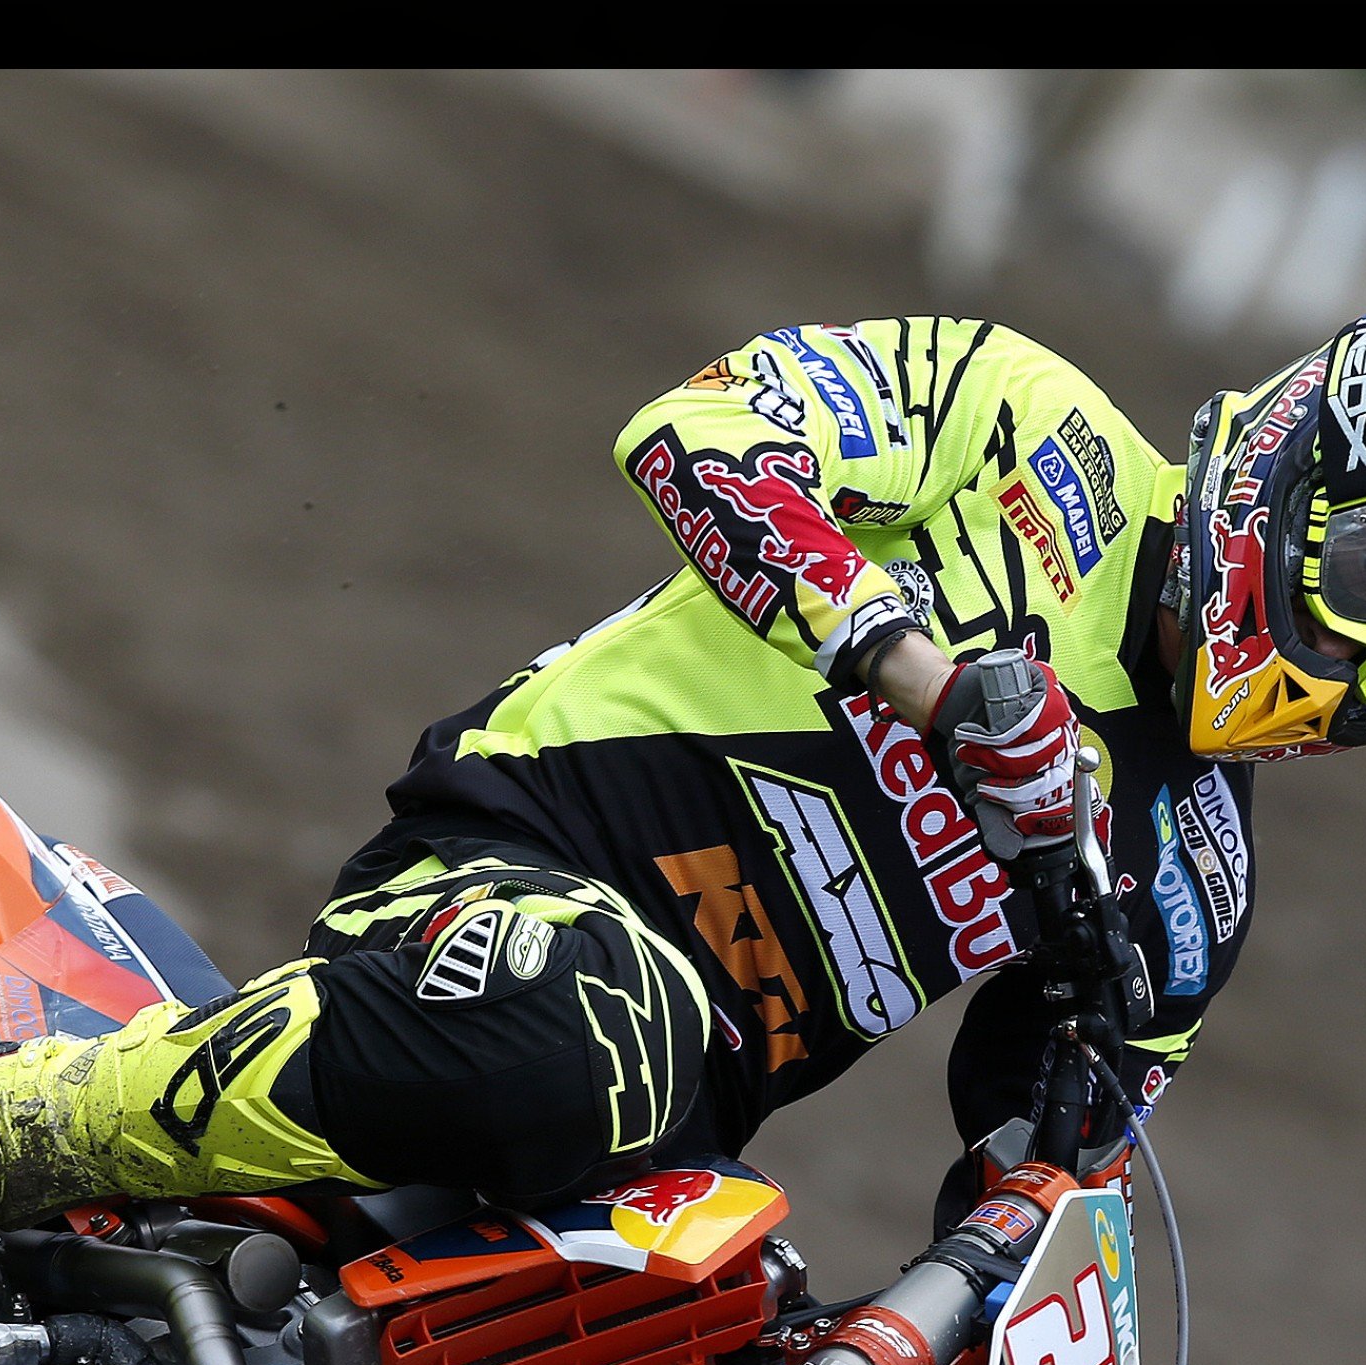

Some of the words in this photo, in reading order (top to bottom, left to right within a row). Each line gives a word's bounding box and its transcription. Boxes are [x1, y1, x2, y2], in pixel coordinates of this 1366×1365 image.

[801, 359, 866, 439] MAPEI
[1056, 482, 1094, 557] MAPEI
[1061, 427, 1113, 537] EMERGENCY
[1070, 411, 1123, 528] BREITLING
[998, 480, 1075, 603] PIRELLI
[1212, 678, 1249, 731] Airoh
[1154, 838, 1203, 988] MOTOREX
[1177, 802, 1208, 850] OPEN
[1205, 871, 1235, 939] GAMES
[5, 976, 41, 1040] DIMOC
